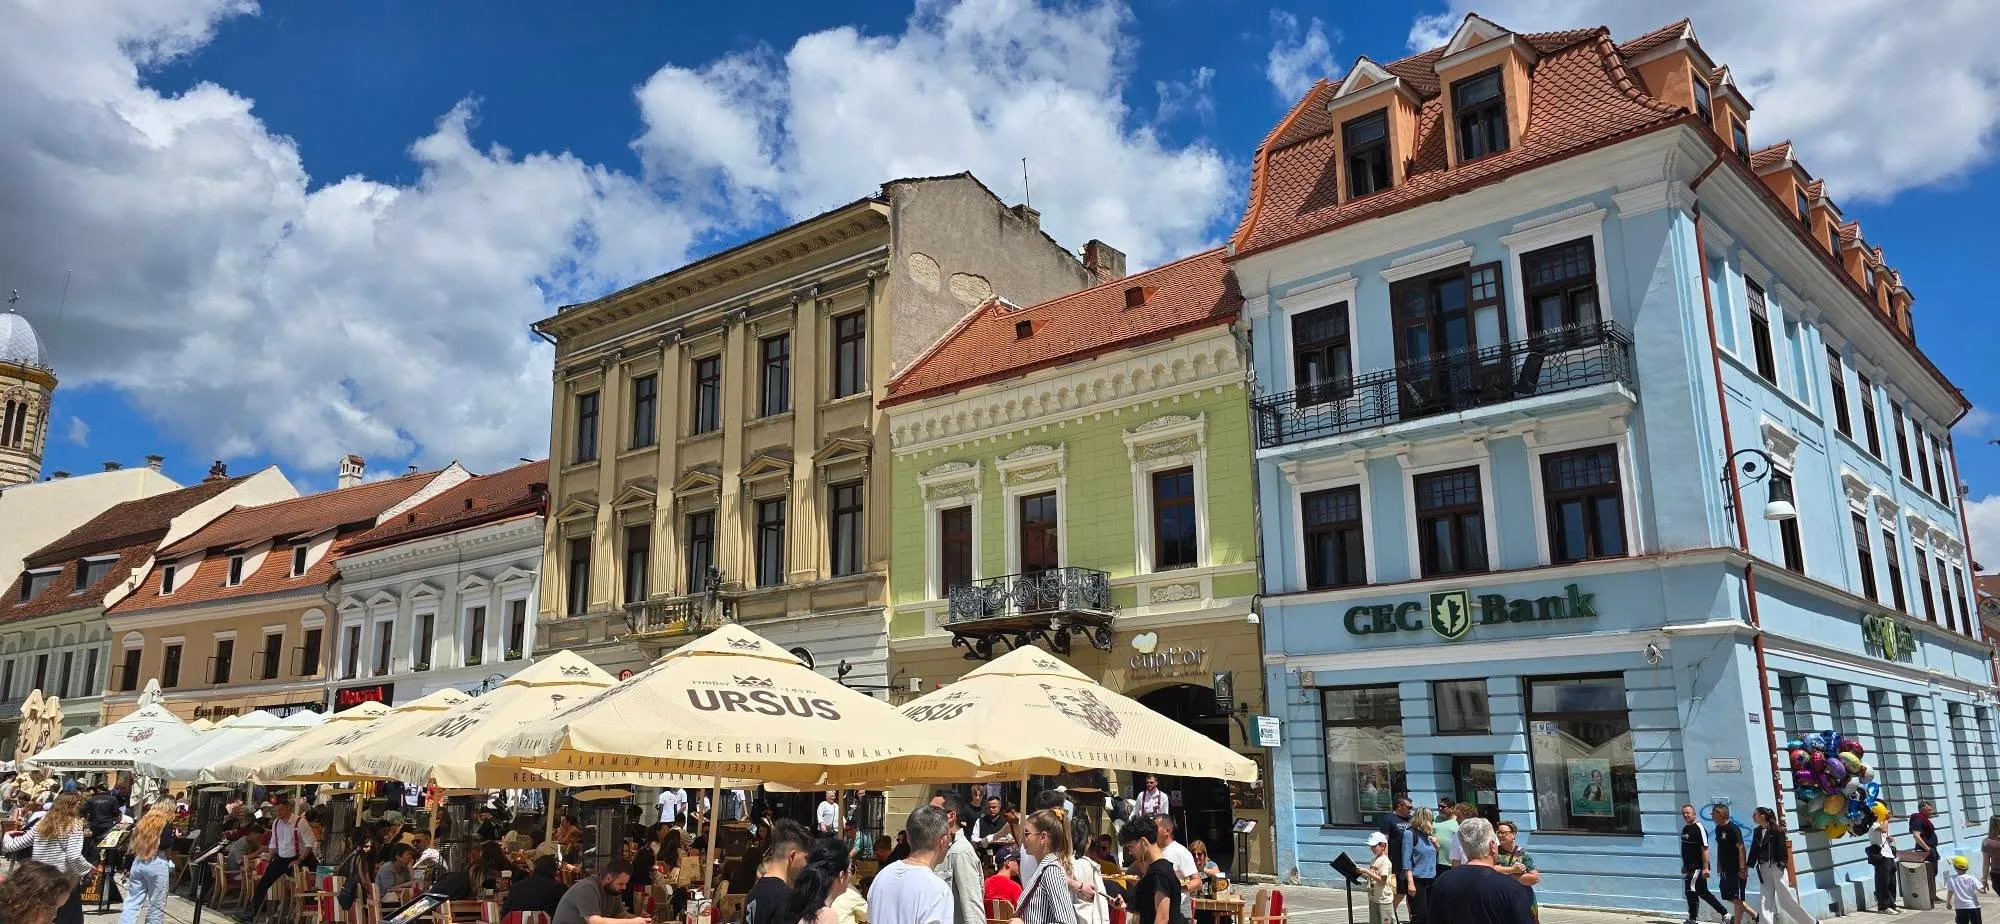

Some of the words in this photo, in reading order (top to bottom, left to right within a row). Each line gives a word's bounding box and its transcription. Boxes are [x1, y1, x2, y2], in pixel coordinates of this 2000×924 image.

[1344, 601, 1423, 636] CEC
[1478, 583, 1600, 625] Bank
[687, 689, 841, 720] URSUS
[666, 739, 723, 752] REGELE
[735, 743, 777, 754] BERII
[788, 742, 806, 755] ÎN
